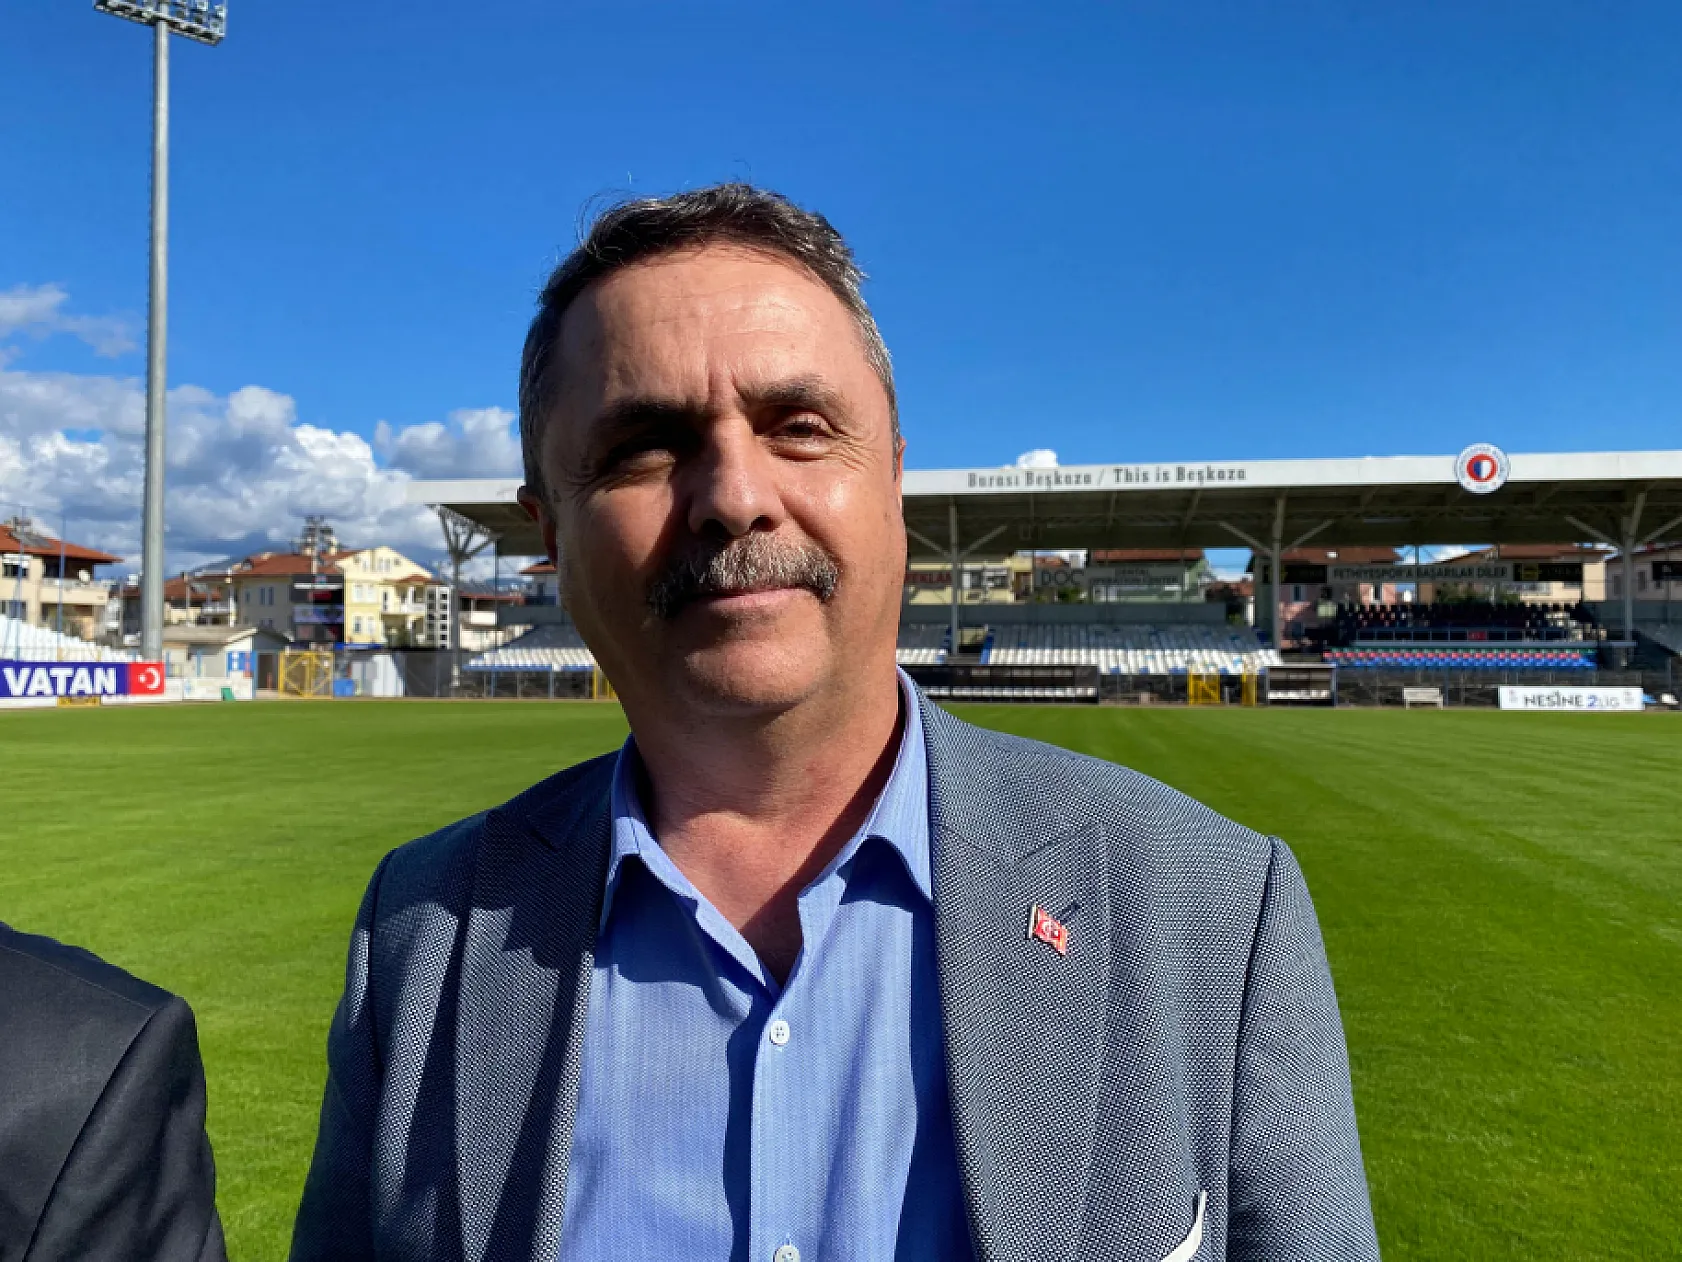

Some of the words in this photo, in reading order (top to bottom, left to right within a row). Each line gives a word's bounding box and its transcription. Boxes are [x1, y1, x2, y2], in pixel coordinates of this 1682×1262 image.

[1113, 466, 1149, 484] This
[1155, 465, 1170, 483] is
[1041, 570, 1085, 586] DOC
[2, 667, 117, 697] VATAN
